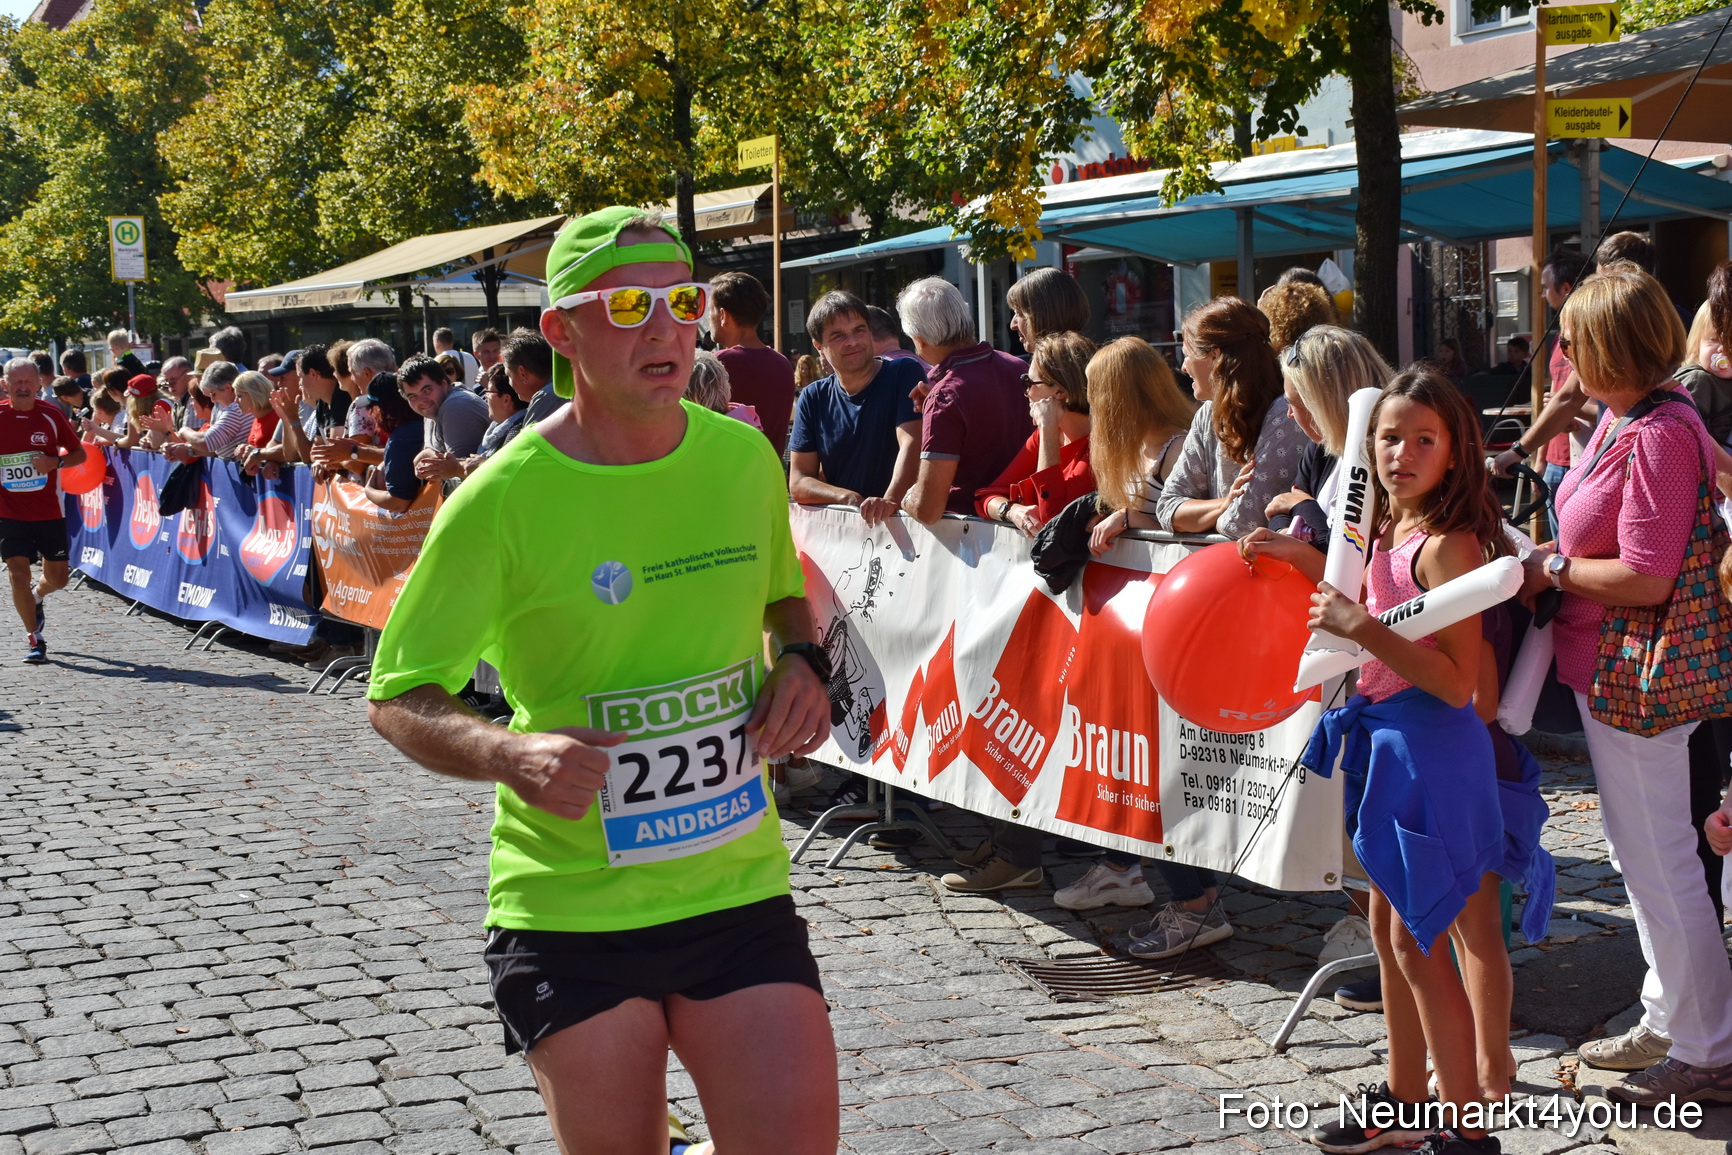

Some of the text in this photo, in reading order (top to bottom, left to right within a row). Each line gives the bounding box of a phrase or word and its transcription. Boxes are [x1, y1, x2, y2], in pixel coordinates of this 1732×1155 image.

[1546, 12, 1606, 25] tartnummern-
[1556, 27, 1592, 42] ausgabe
[1555, 106, 1613, 118] Kleiderbeutel-
[1565, 120, 1601, 133] ausgabe
[745, 146, 774, 161] Toiletten
[1343, 466, 1368, 524] swn
[400, 521, 413, 530] und
[409, 506, 434, 517] Partner
[642, 544, 757, 574] Freie katholische Volksschule
[644, 575, 654, 584] im
[655, 571, 674, 582] Haus
[674, 568, 685, 577] St.
[686, 561, 714, 574] Marien,
[1058, 646, 1077, 684] Seit 1929
[603, 670, 747, 734] BOCK
[926, 700, 960, 758] Braun
[971, 676, 1046, 770] Braun
[1180, 723, 1196, 741] Am
[1259, 732, 1265, 748] 8
[1065, 703, 1150, 787] Braun
[1180, 743, 1226, 764] D-92318
[618, 724, 747, 804] 2237
[984, 741, 1034, 791] Sicher ist sicher
[1097, 783, 1161, 813] Sicher ist sicher
[1181, 772, 1275, 802] Tel. 09181 / 2307-0
[635, 791, 751, 843] ANDREAS
[1184, 791, 1205, 809] Fax
[1208, 794, 1237, 815] 09181
[1240, 799, 1245, 816] /
